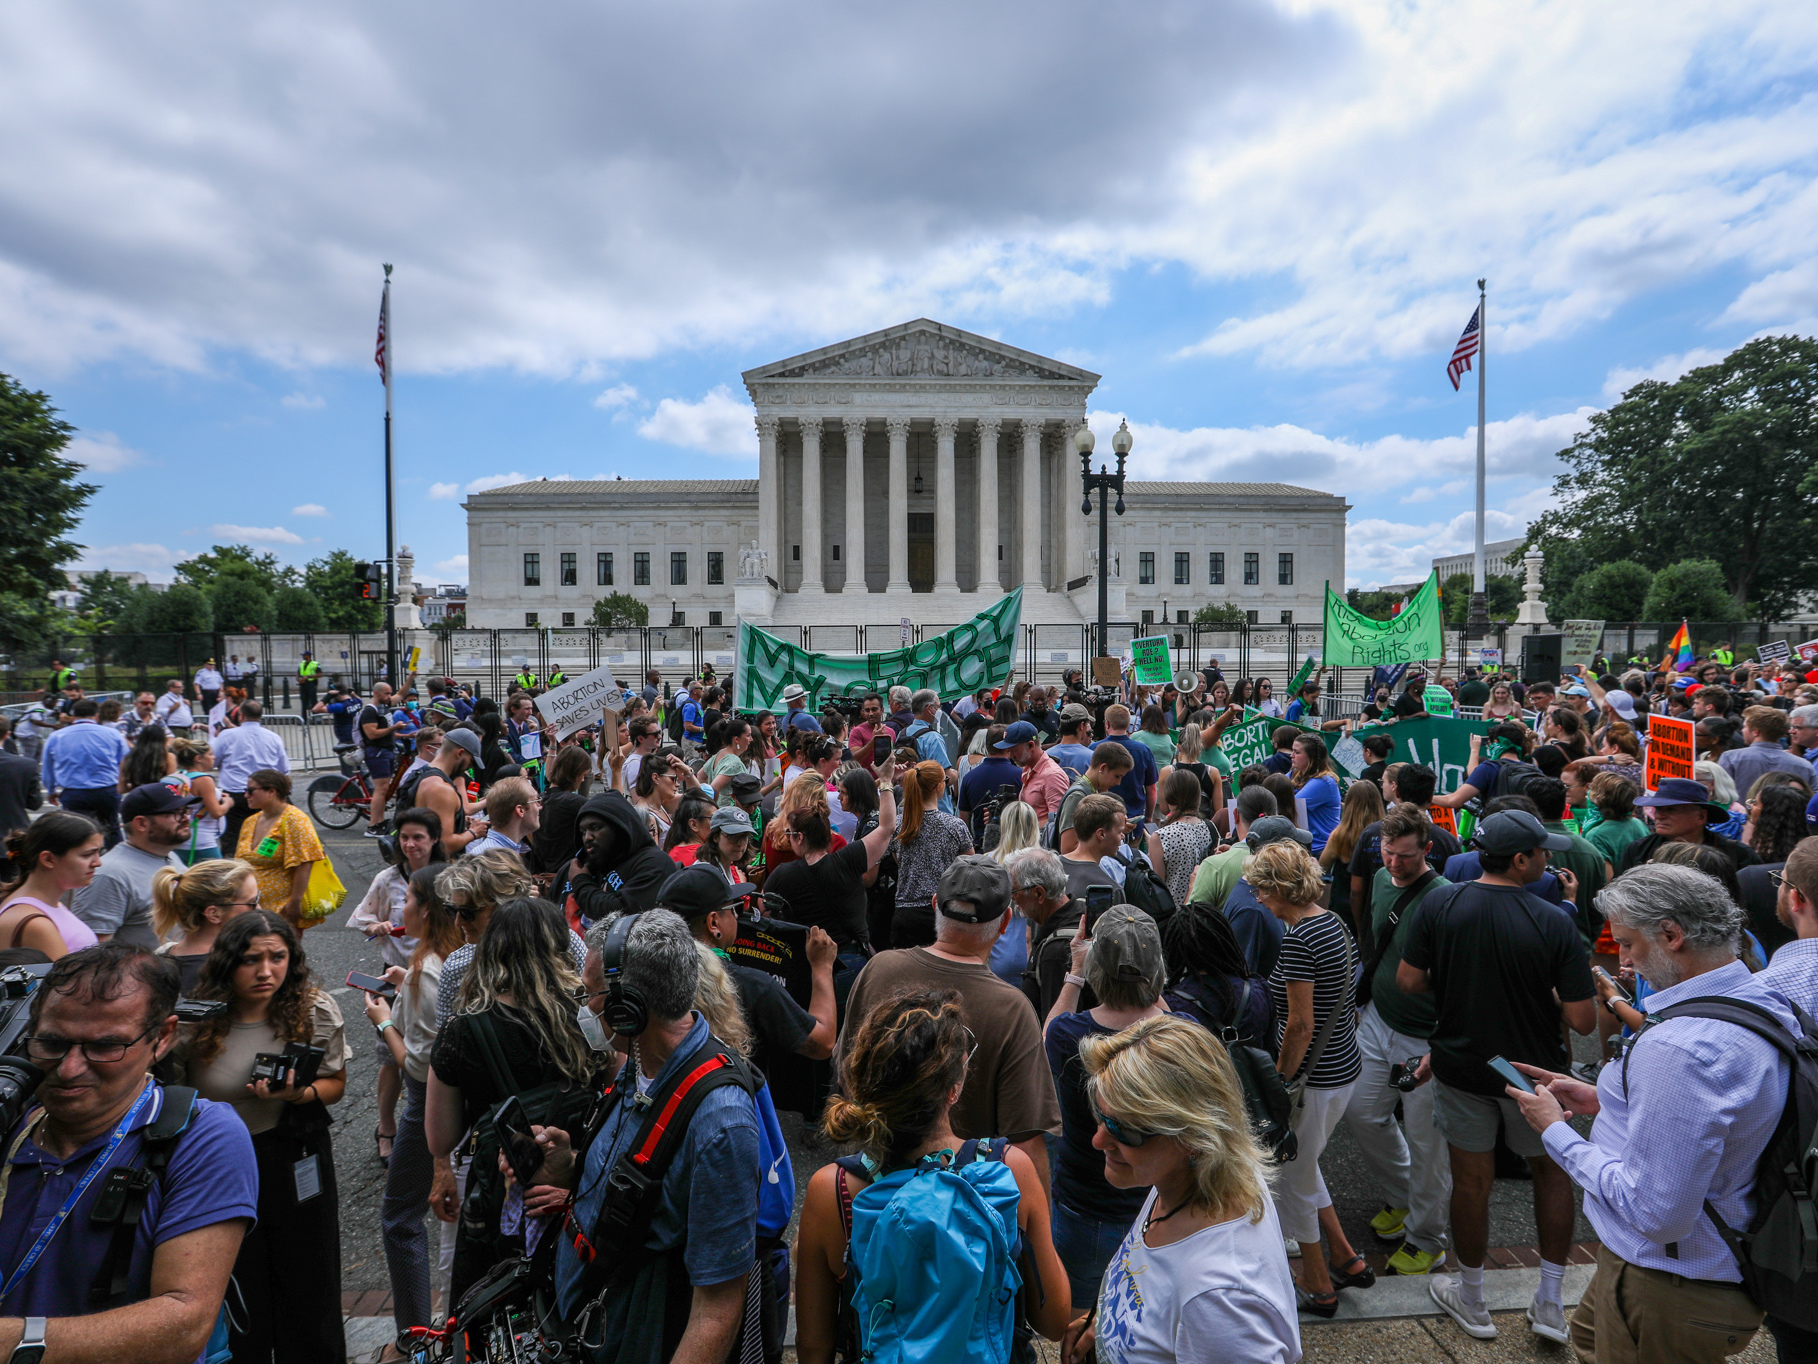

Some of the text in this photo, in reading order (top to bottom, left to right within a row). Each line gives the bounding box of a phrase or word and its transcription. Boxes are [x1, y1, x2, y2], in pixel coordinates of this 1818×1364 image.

[747, 597, 1012, 680] MY BODY
[1135, 639, 1164, 649] OVERTURN
[1139, 657, 1153, 665] HELL
[551, 678, 605, 713] ABORTION
[746, 666, 827, 713] MY
[555, 689, 620, 730] SAVES LIVES
[1653, 723, 1689, 743] ABORTION
[1651, 740, 1692, 761] ON DEMAND
[1649, 758, 1656, 769] &
[1657, 757, 1691, 780] WITHOUT
[738, 947, 782, 964] SURRENDER!
[757, 942, 775, 953] BACK
